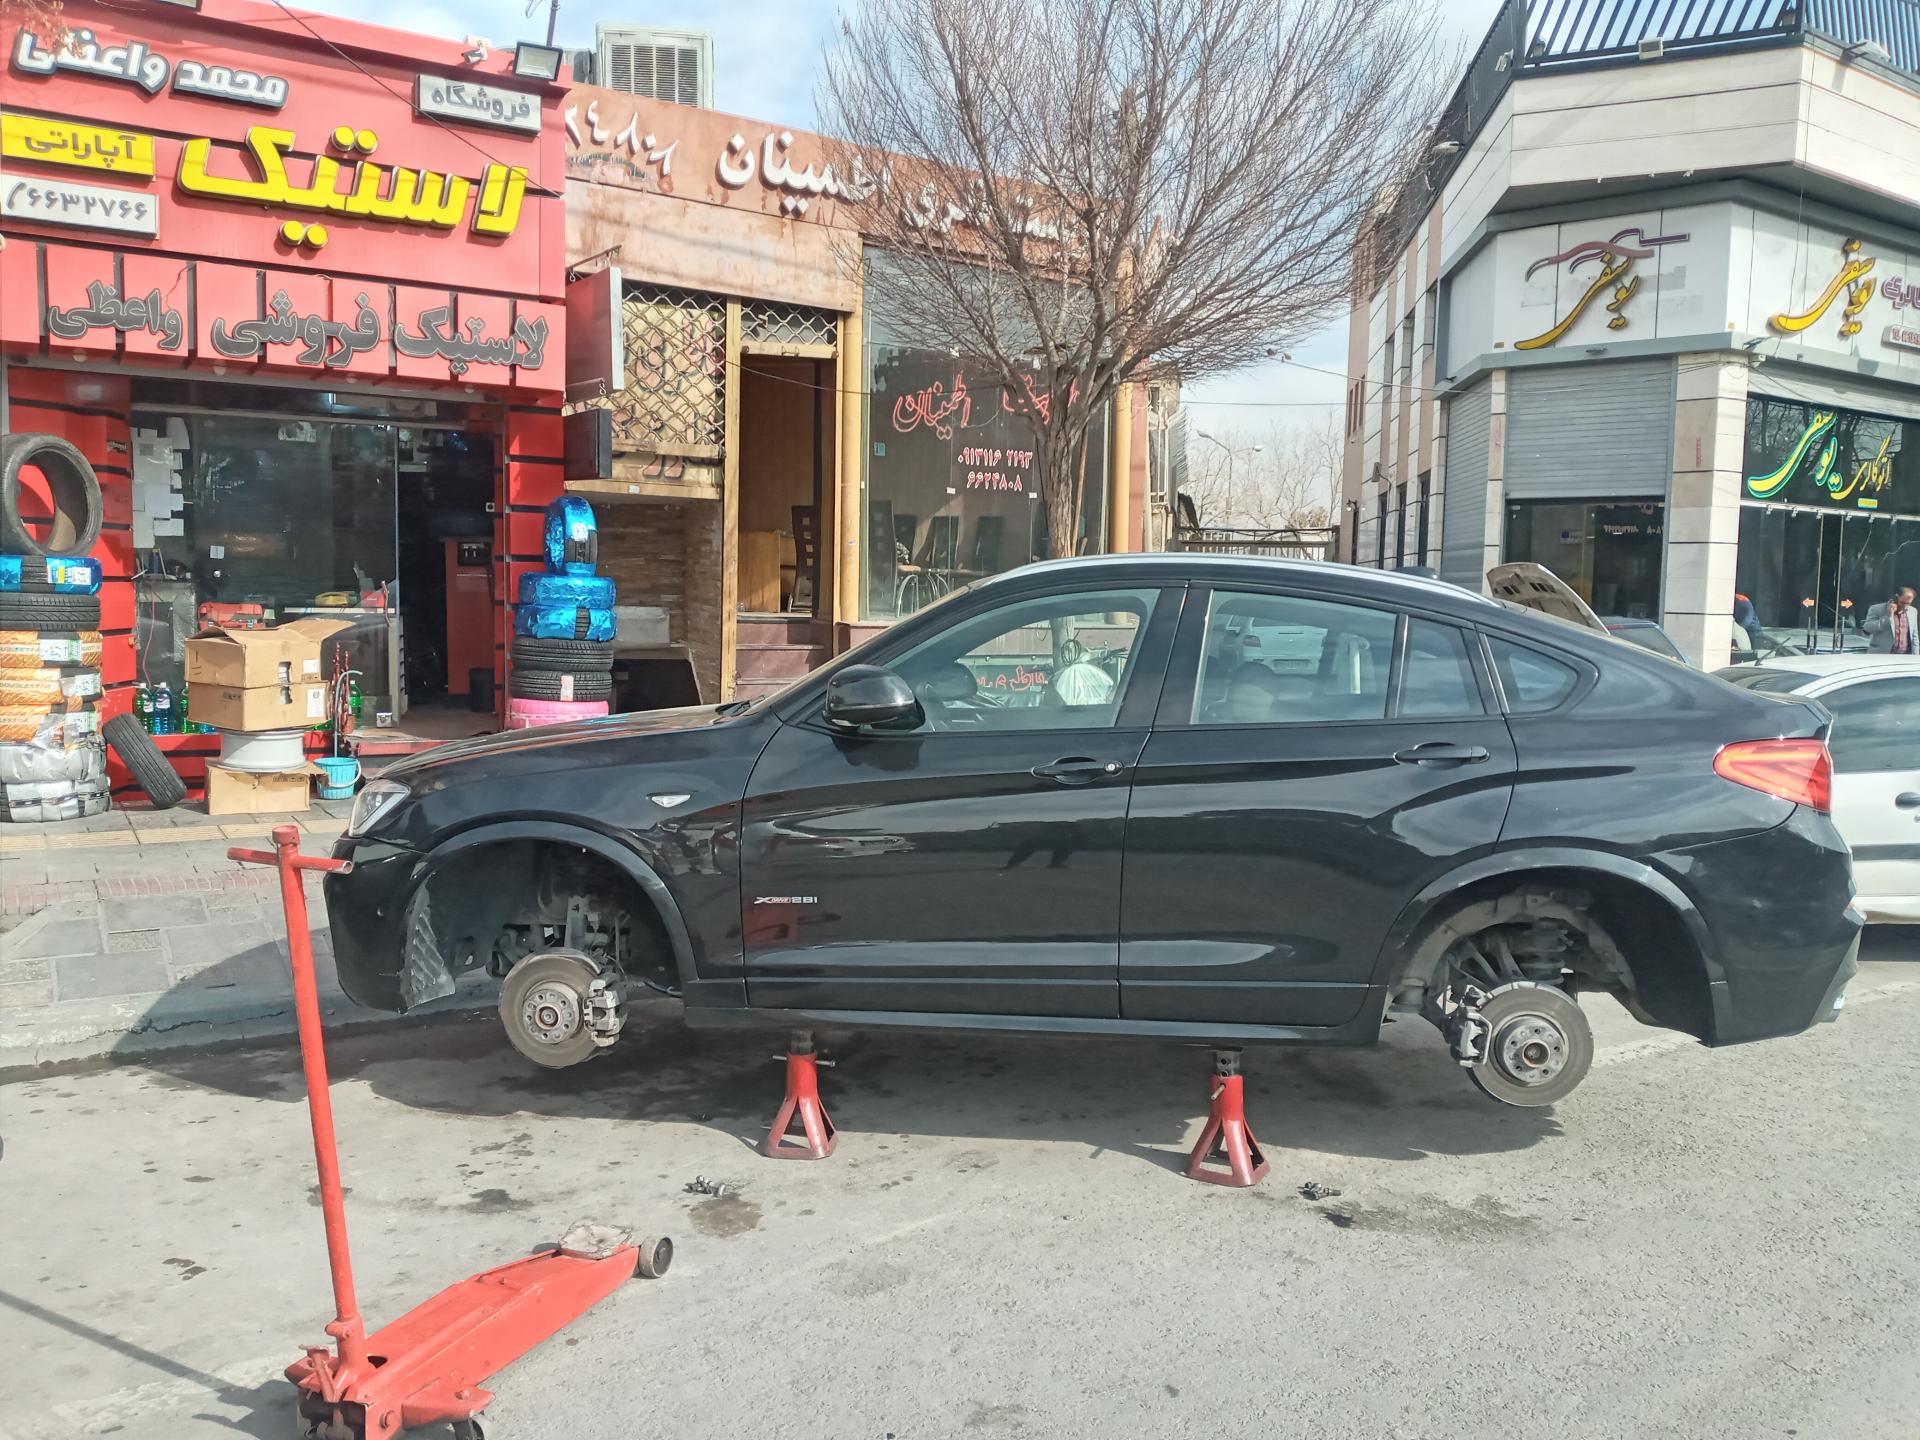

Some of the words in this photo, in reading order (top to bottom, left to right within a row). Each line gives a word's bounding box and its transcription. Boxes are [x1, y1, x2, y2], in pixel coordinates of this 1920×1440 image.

[179, 63, 286, 107] محمد
[432, 85, 530, 121] فروشگاه
[25, 130, 136, 168] آپاراتی
[179, 126, 528, 248] لاستیک
[47, 280, 183, 349] واعظی
[211, 290, 380, 367] فروشی
[394, 306, 547, 374] لاستیک
